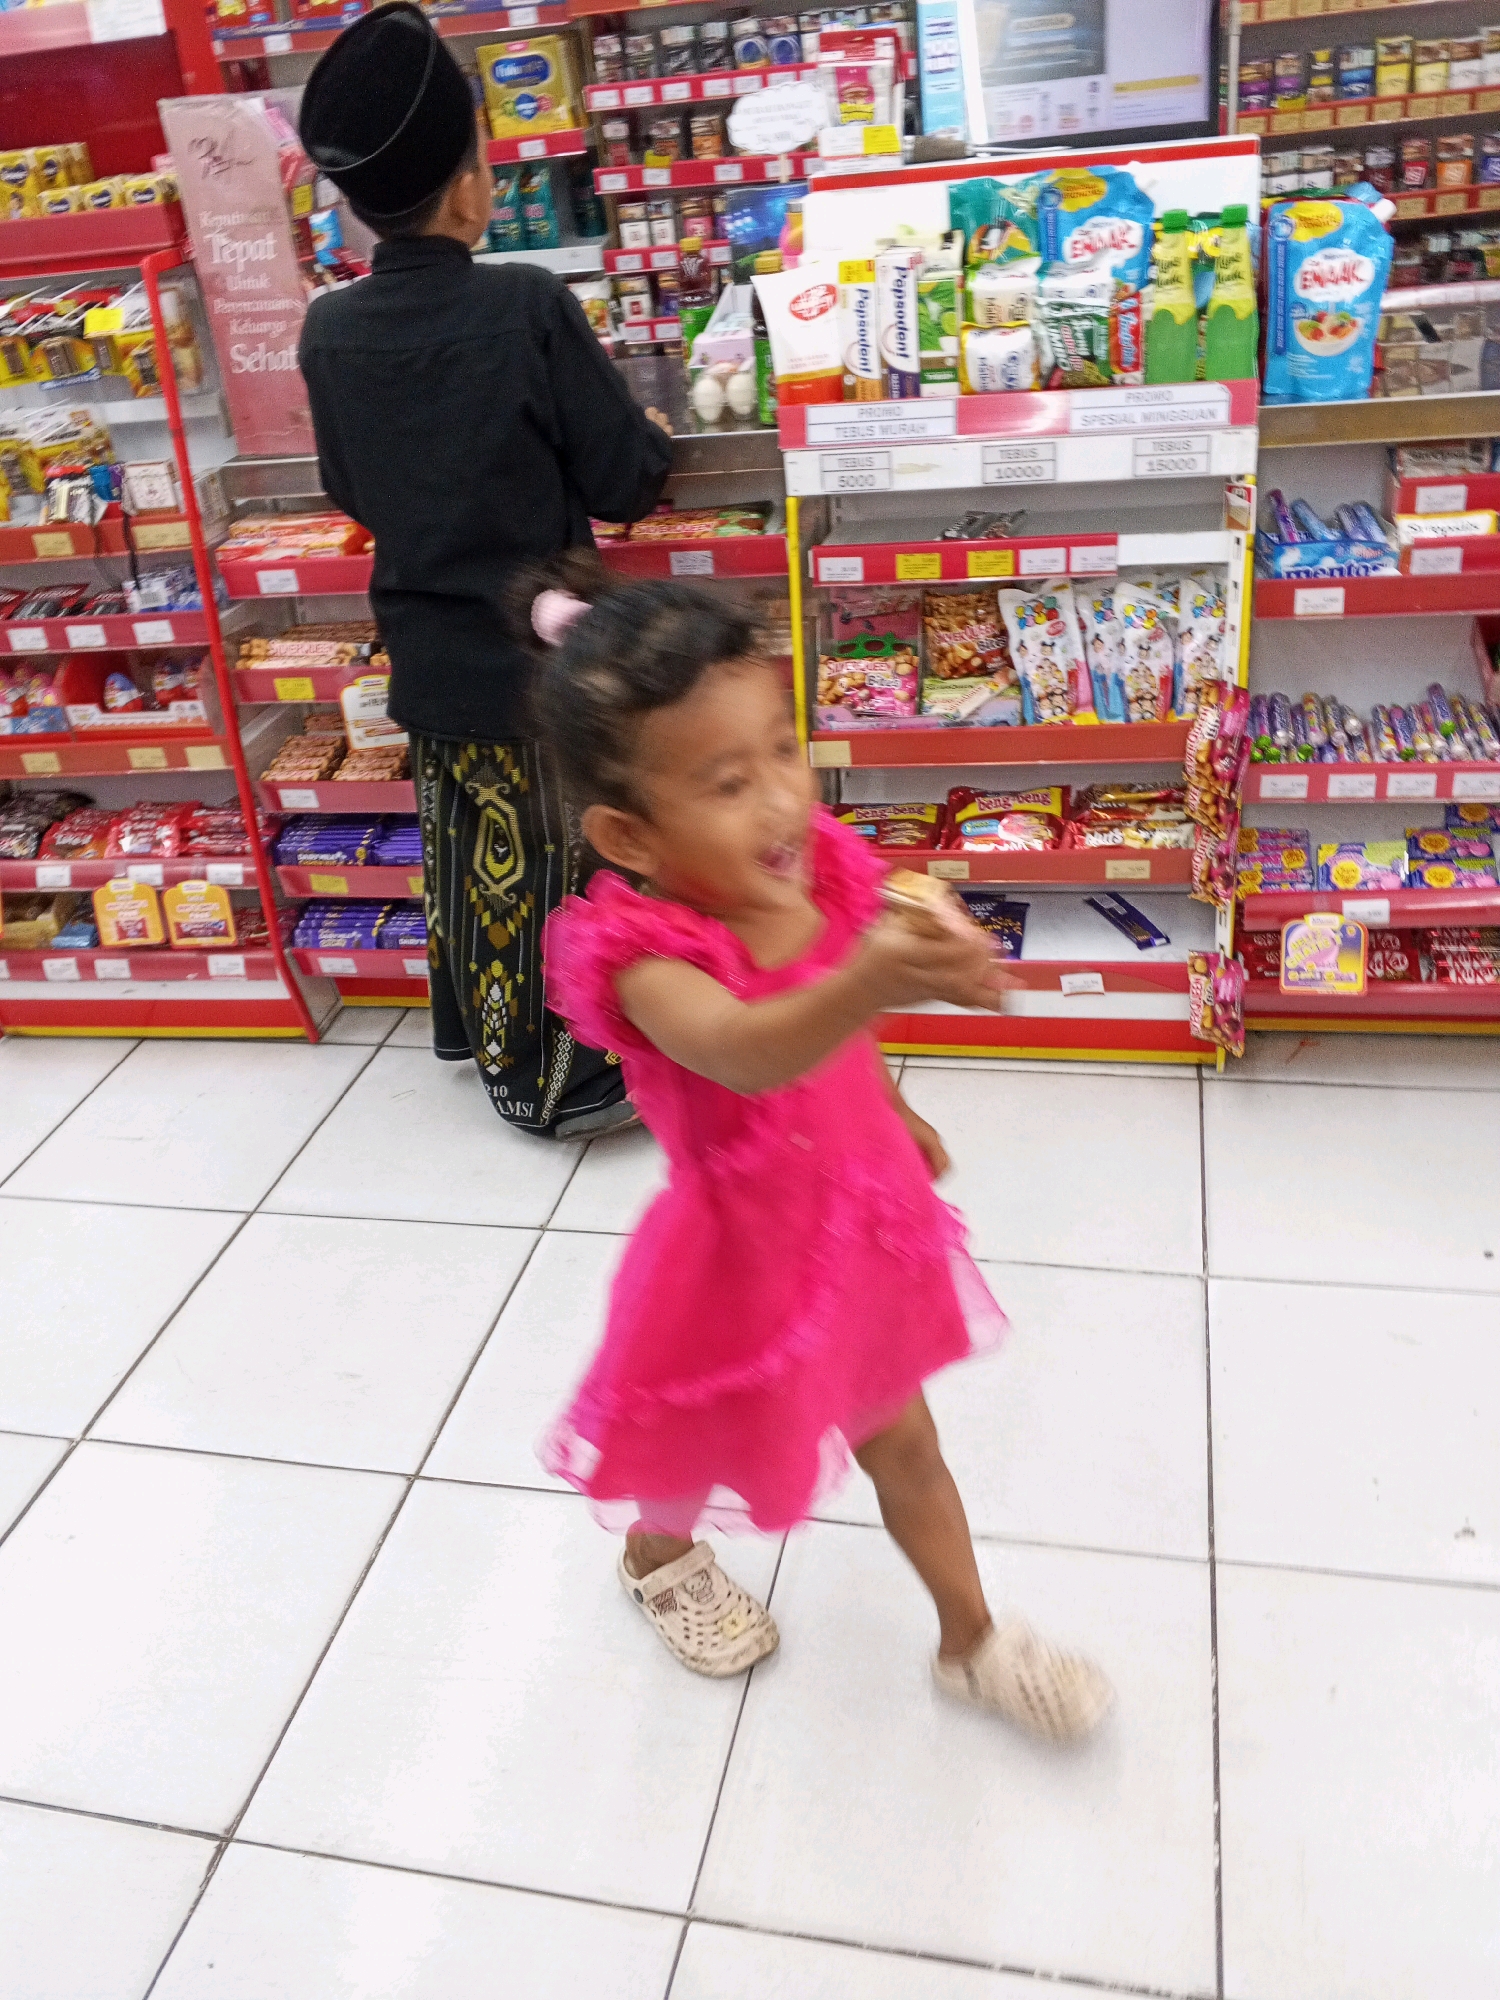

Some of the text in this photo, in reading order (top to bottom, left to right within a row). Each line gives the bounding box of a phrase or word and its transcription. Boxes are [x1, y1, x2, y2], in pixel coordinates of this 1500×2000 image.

[203, 230, 278, 273] Tepat
[893, 266, 911, 359] Pepsodent
[854, 288, 873, 373] Pepsodent
[229, 342, 300, 374] Sehat
[1125, 390, 1174, 404] PROMO
[857, 405, 904, 419] PROMO
[1080, 408, 1218, 427] SPESIAL MINGGUAN
[834, 422, 928, 439] TEBUS MURAH
[998, 447, 1039, 460] TEBUS
[1151, 439, 1193, 453] TEBUS
[836, 456, 875, 469] TEBUS
[1145, 456, 1198, 473] 15000
[994, 464, 1045, 480] 10000
[837, 473, 877, 488] 5000
